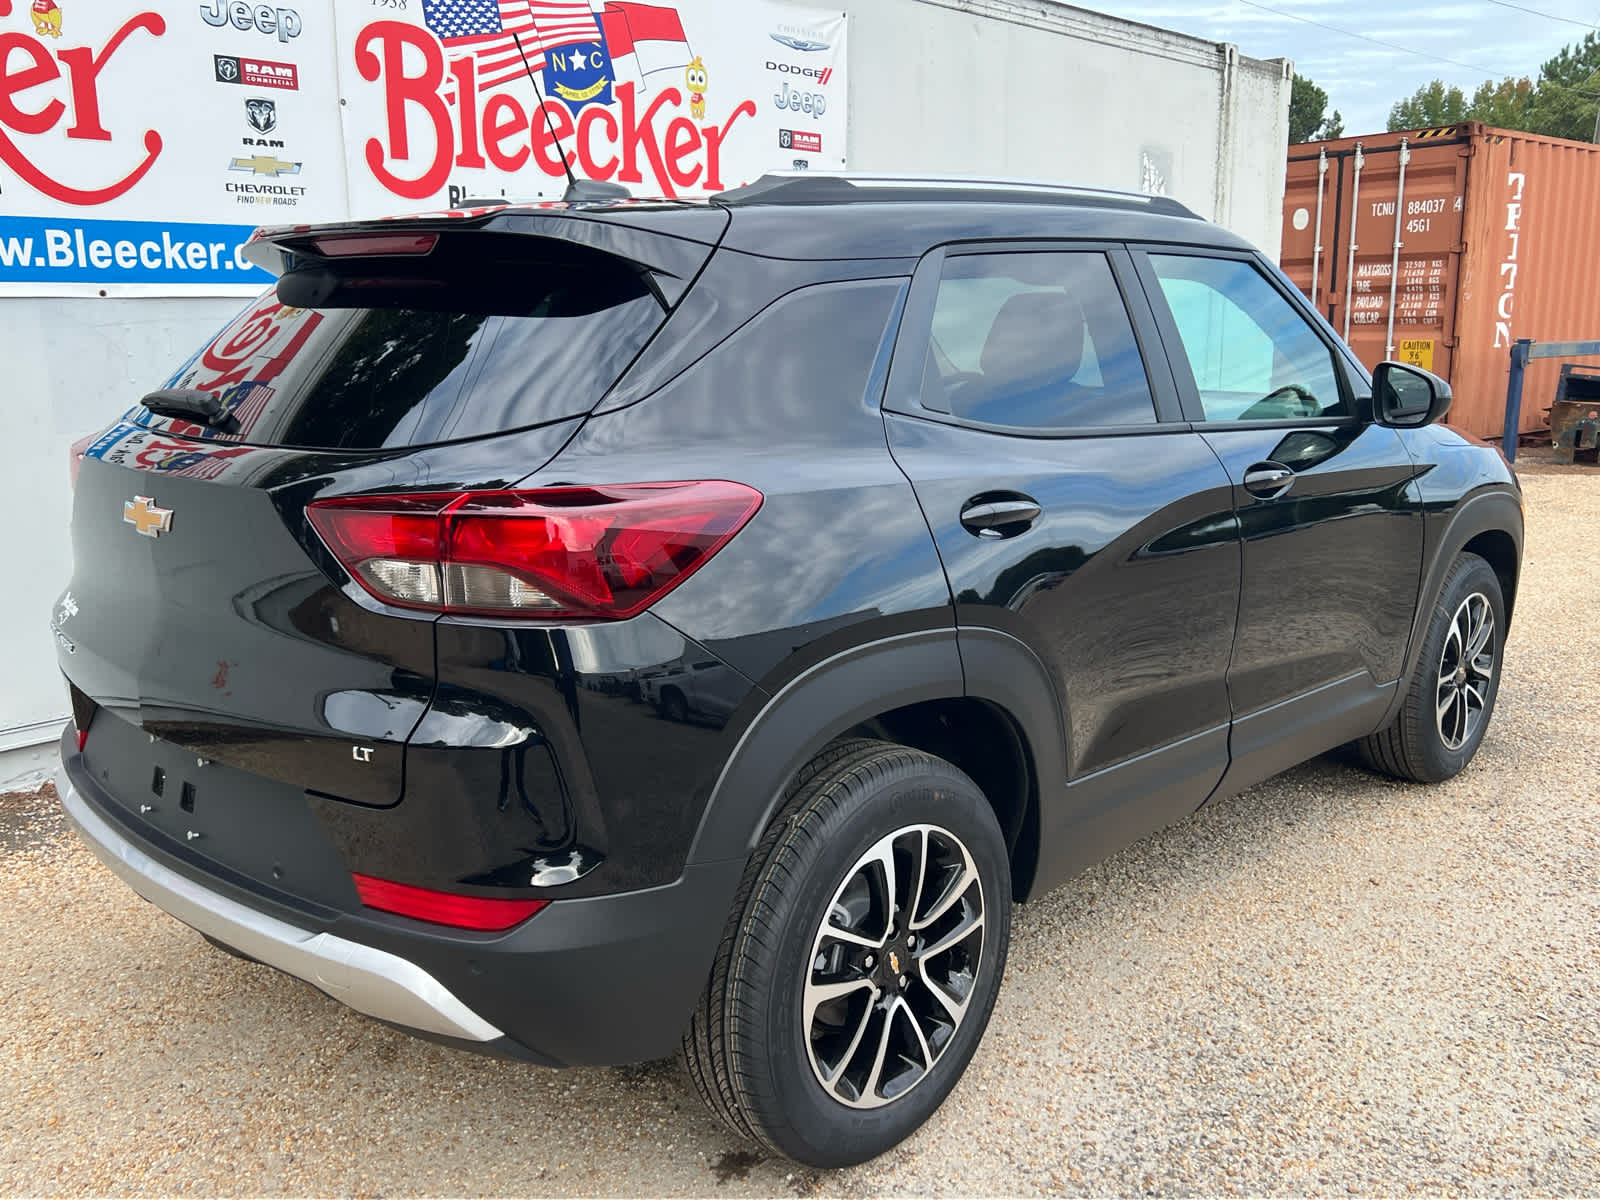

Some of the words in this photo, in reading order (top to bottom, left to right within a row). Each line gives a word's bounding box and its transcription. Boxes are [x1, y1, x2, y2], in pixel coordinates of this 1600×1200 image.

[200, 0, 302, 43] Jeep
[552, 52, 566, 72] N
[590, 50, 604, 69] C
[245, 63, 293, 77] RAM
[765, 61, 824, 78] DODGE
[246, 76, 294, 86] COMMERCIAL
[774, 82, 826, 119] Jeep
[354, 20, 757, 199] Bleecker
[242, 137, 284, 148] RAM
[794, 134, 820, 143] RAM
[225, 182, 306, 196] CHEVROLET
[1371, 202, 1395, 216] TCNU
[1407, 199, 1446, 215] 884037
[1453, 196, 1462, 210] 4
[1406, 218, 1430, 232] 45G1
[1354, 295, 1384, 309] PAYLOAD
[1403, 341, 1431, 351] CAUTION
[353, 746, 374, 762] LT
